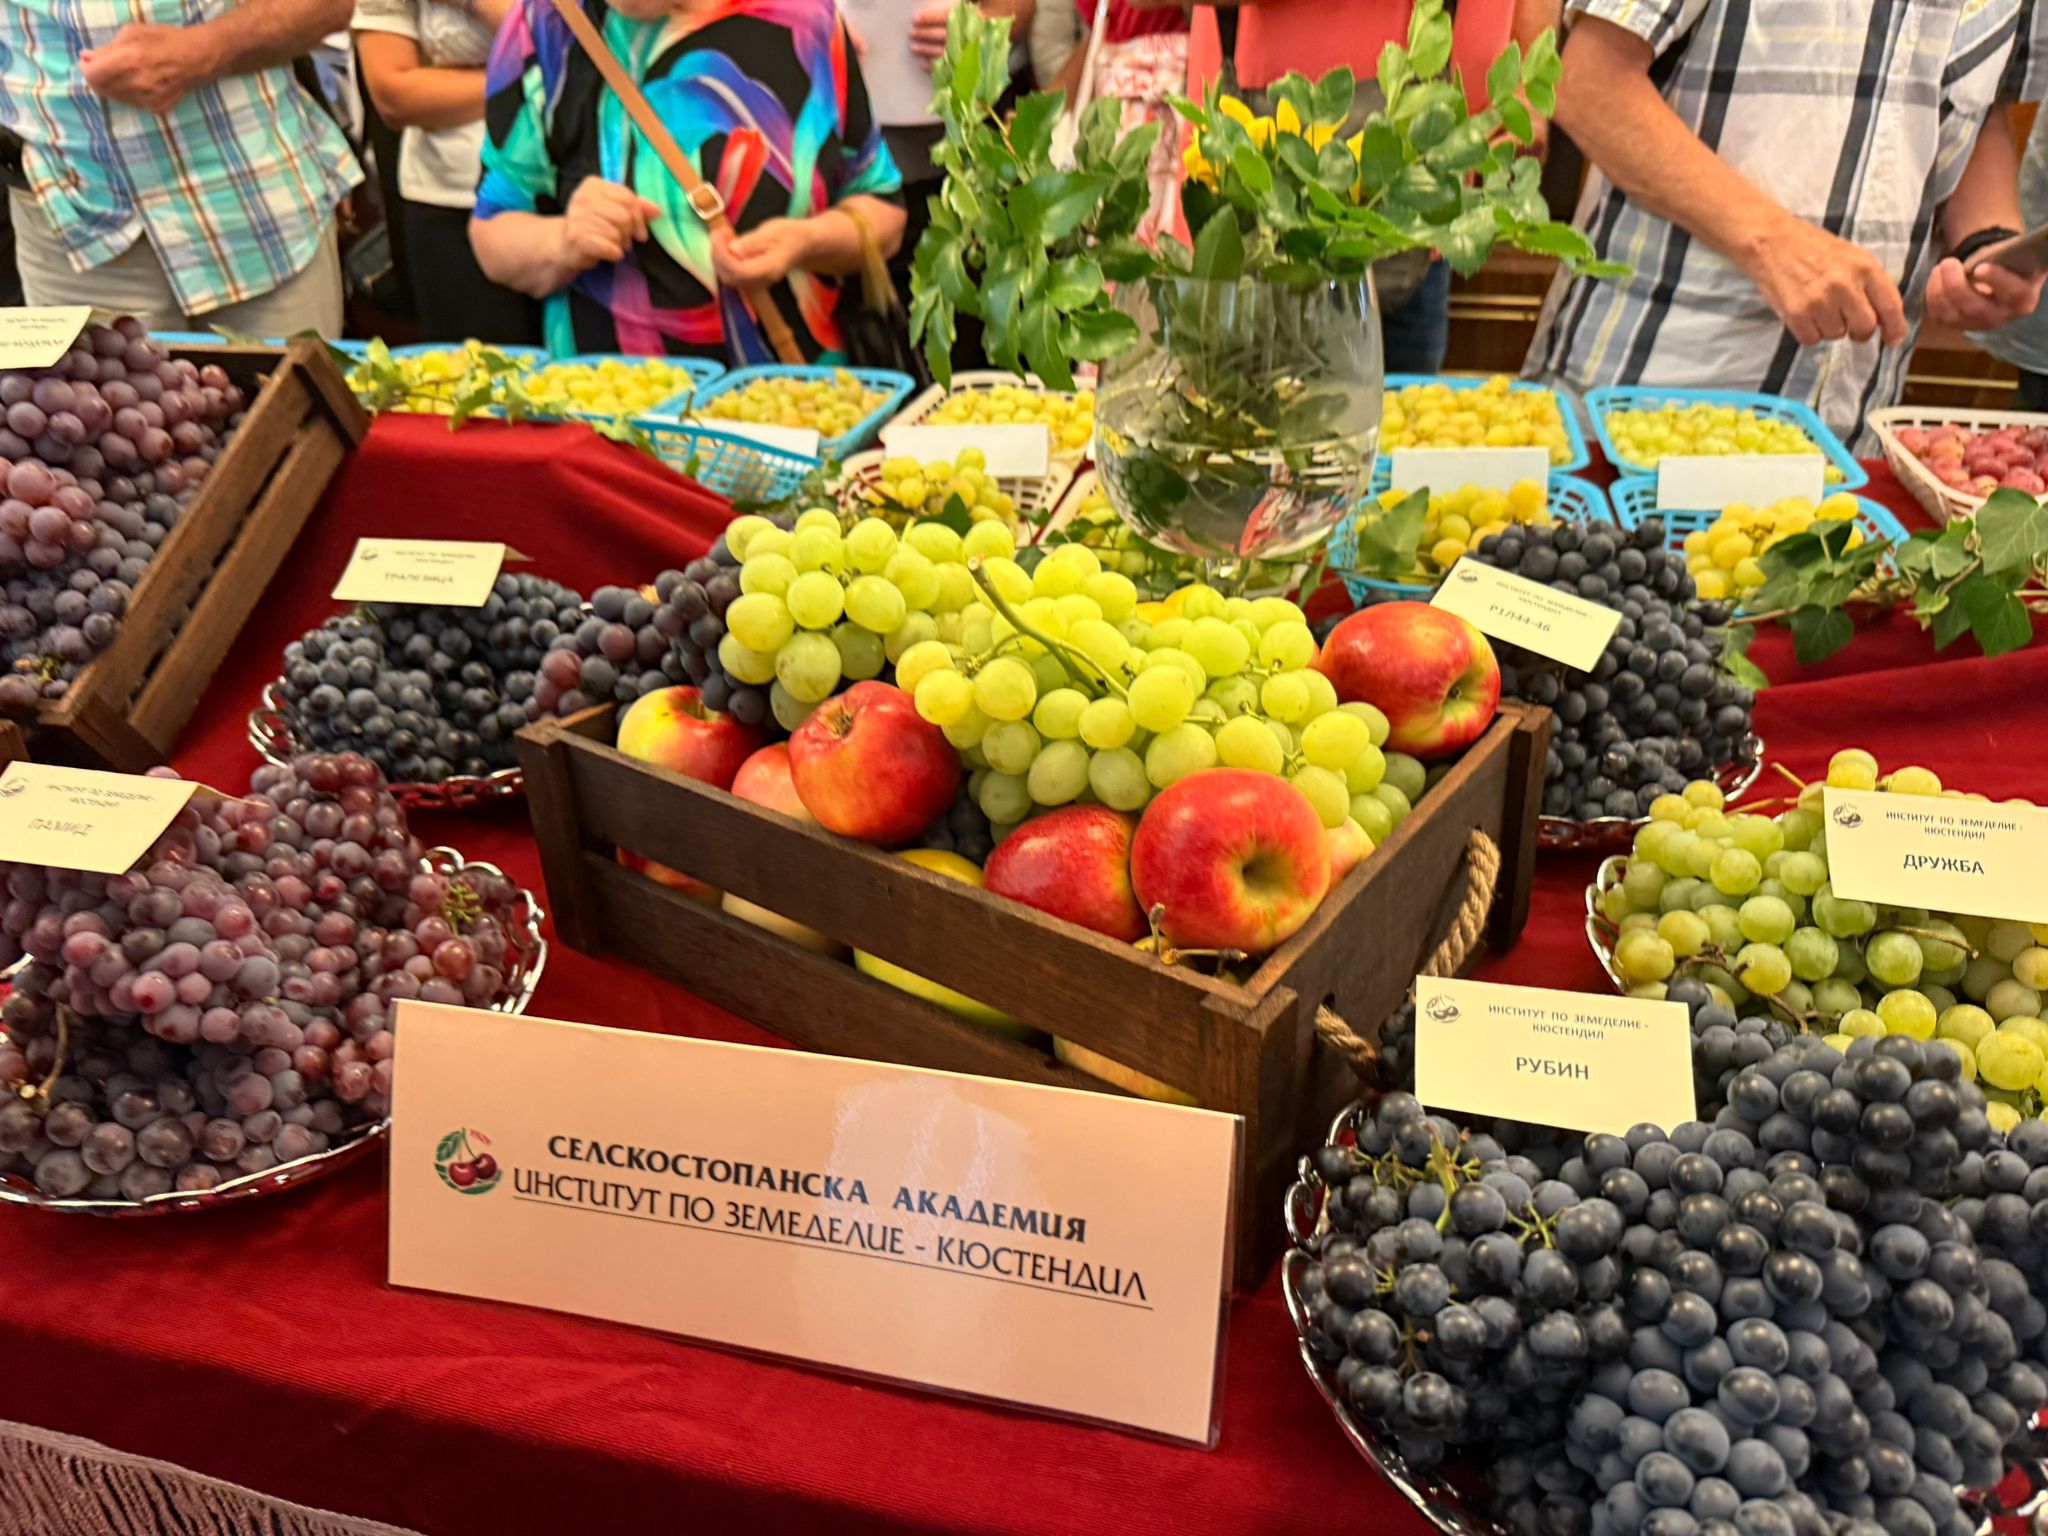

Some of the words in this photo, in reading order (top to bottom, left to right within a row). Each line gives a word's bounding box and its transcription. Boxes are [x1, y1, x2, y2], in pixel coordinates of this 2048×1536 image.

[1885, 810, 1935, 824] ИНСТИТУТ
[1939, 815, 1955, 826] ПО
[1959, 817, 2018, 831] ЗЕМЕДЕЛИЕ
[1924, 825, 1986, 841] КЮСТЕНДИЛ
[1902, 853, 1985, 875] ДРУЖБА
[1488, 1003, 1547, 1020] ИНСТИТУТ
[1551, 1011, 1569, 1022] ПО
[1574, 1013, 1643, 1030] ЗЕМЕДЕЛИЕ
[1532, 1023, 1605, 1041] КЮСТЕНДИЛ
[1515, 1056, 1590, 1080] РУБИН
[548, 1134, 870, 1206] СЕЛСКОСТОПАНСКА
[892, 1186, 1087, 1244] АКАДЕМИЯ
[513, 1167, 662, 1215] ИНСТИТУТ
[669, 1193, 715, 1223] ПО
[725, 1202, 905, 1255] ЗЕМЕДЕЛИЕ
[937, 1235, 1148, 1302] КЮСТЕНДИЛ
